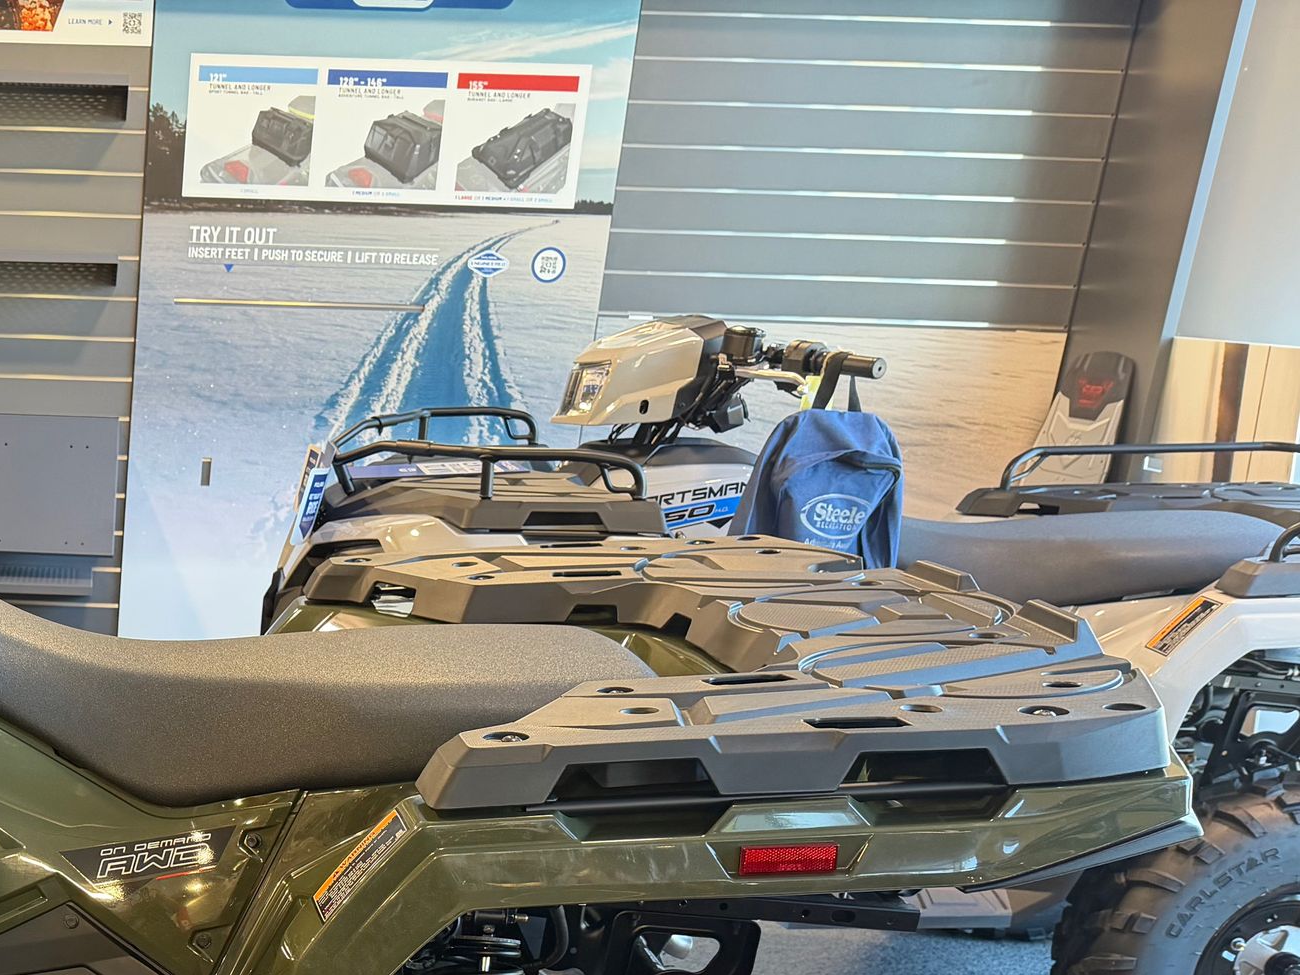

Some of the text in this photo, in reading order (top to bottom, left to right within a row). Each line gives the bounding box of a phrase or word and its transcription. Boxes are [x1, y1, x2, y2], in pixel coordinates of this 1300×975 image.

[189, 225, 277, 245] TRY IT OUT
[188, 247, 439, 266] INSERT FEET PUSH TO SECURE LIFT TO RELEASE
[813, 502, 866, 525] Steele
[100, 833, 211, 857] ON DEMAND
[97, 843, 214, 878] AWD
